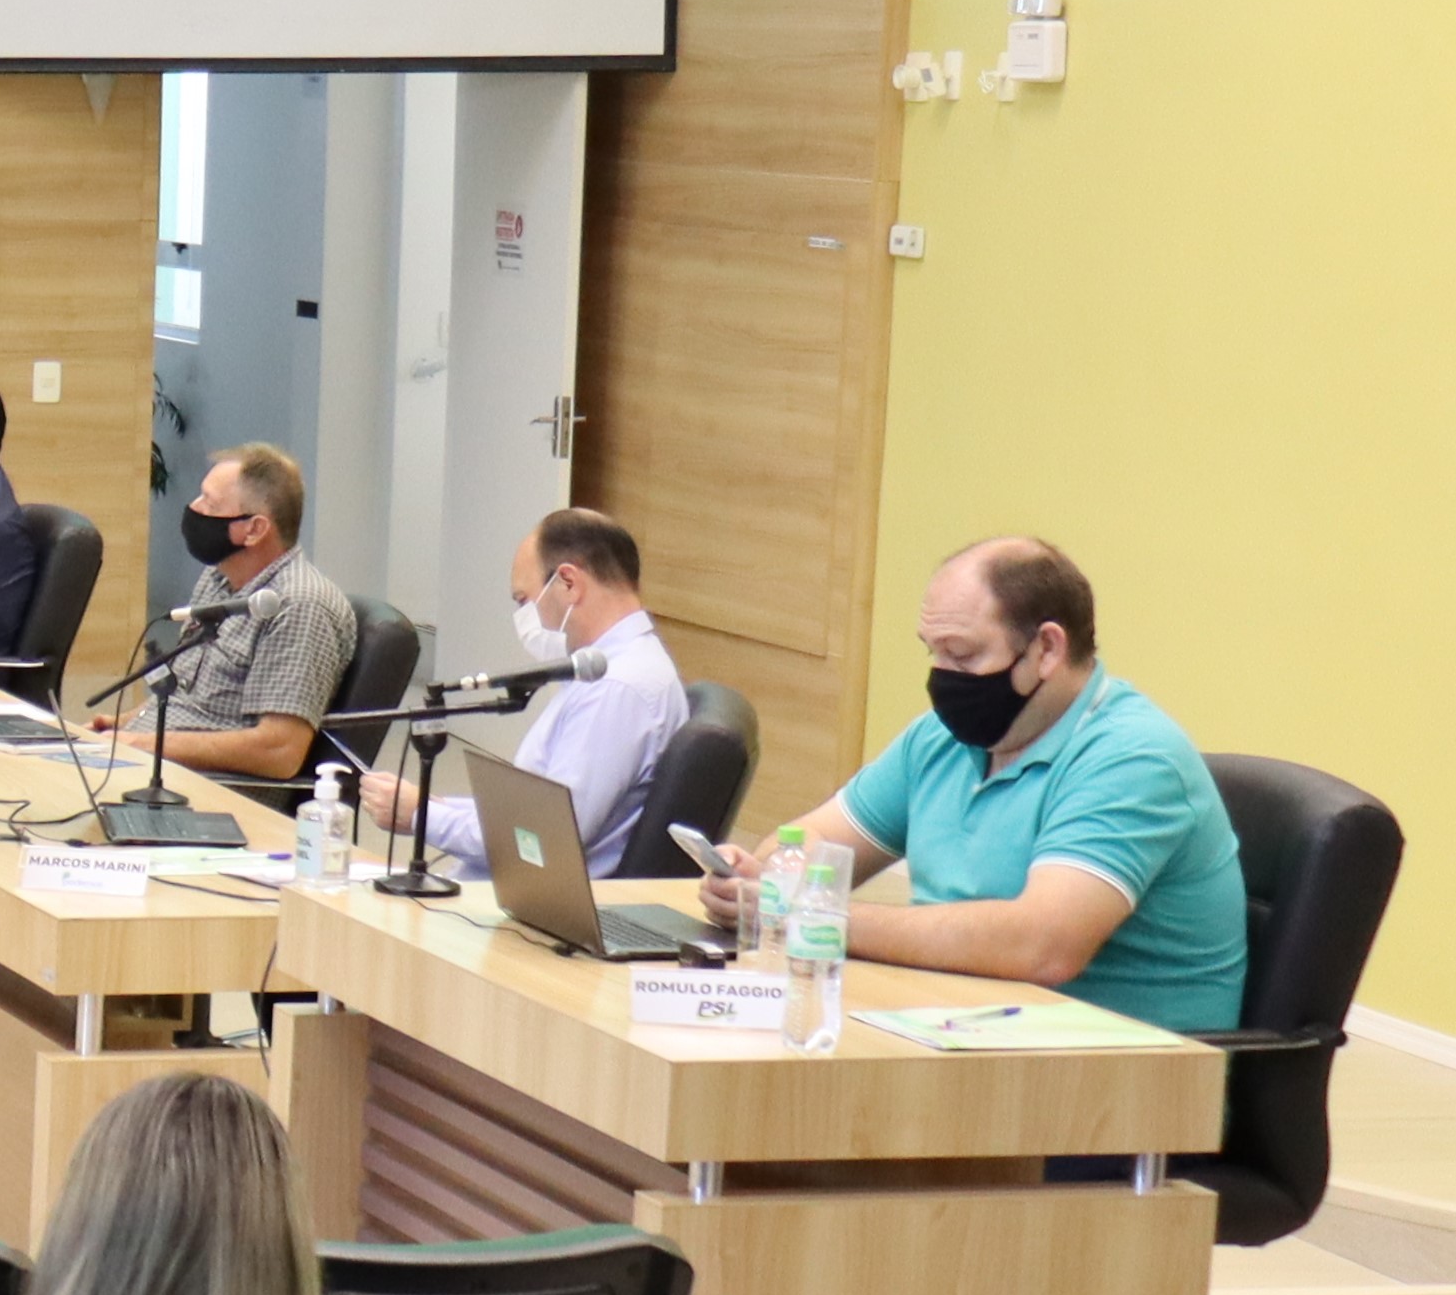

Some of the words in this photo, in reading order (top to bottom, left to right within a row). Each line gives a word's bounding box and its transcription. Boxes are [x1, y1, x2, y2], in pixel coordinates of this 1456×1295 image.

[29, 855, 91, 869] MARCOS
[93, 860, 147, 874] MARINI
[635, 980, 712, 995] ROMULO
[698, 1000, 737, 1018] PSL
